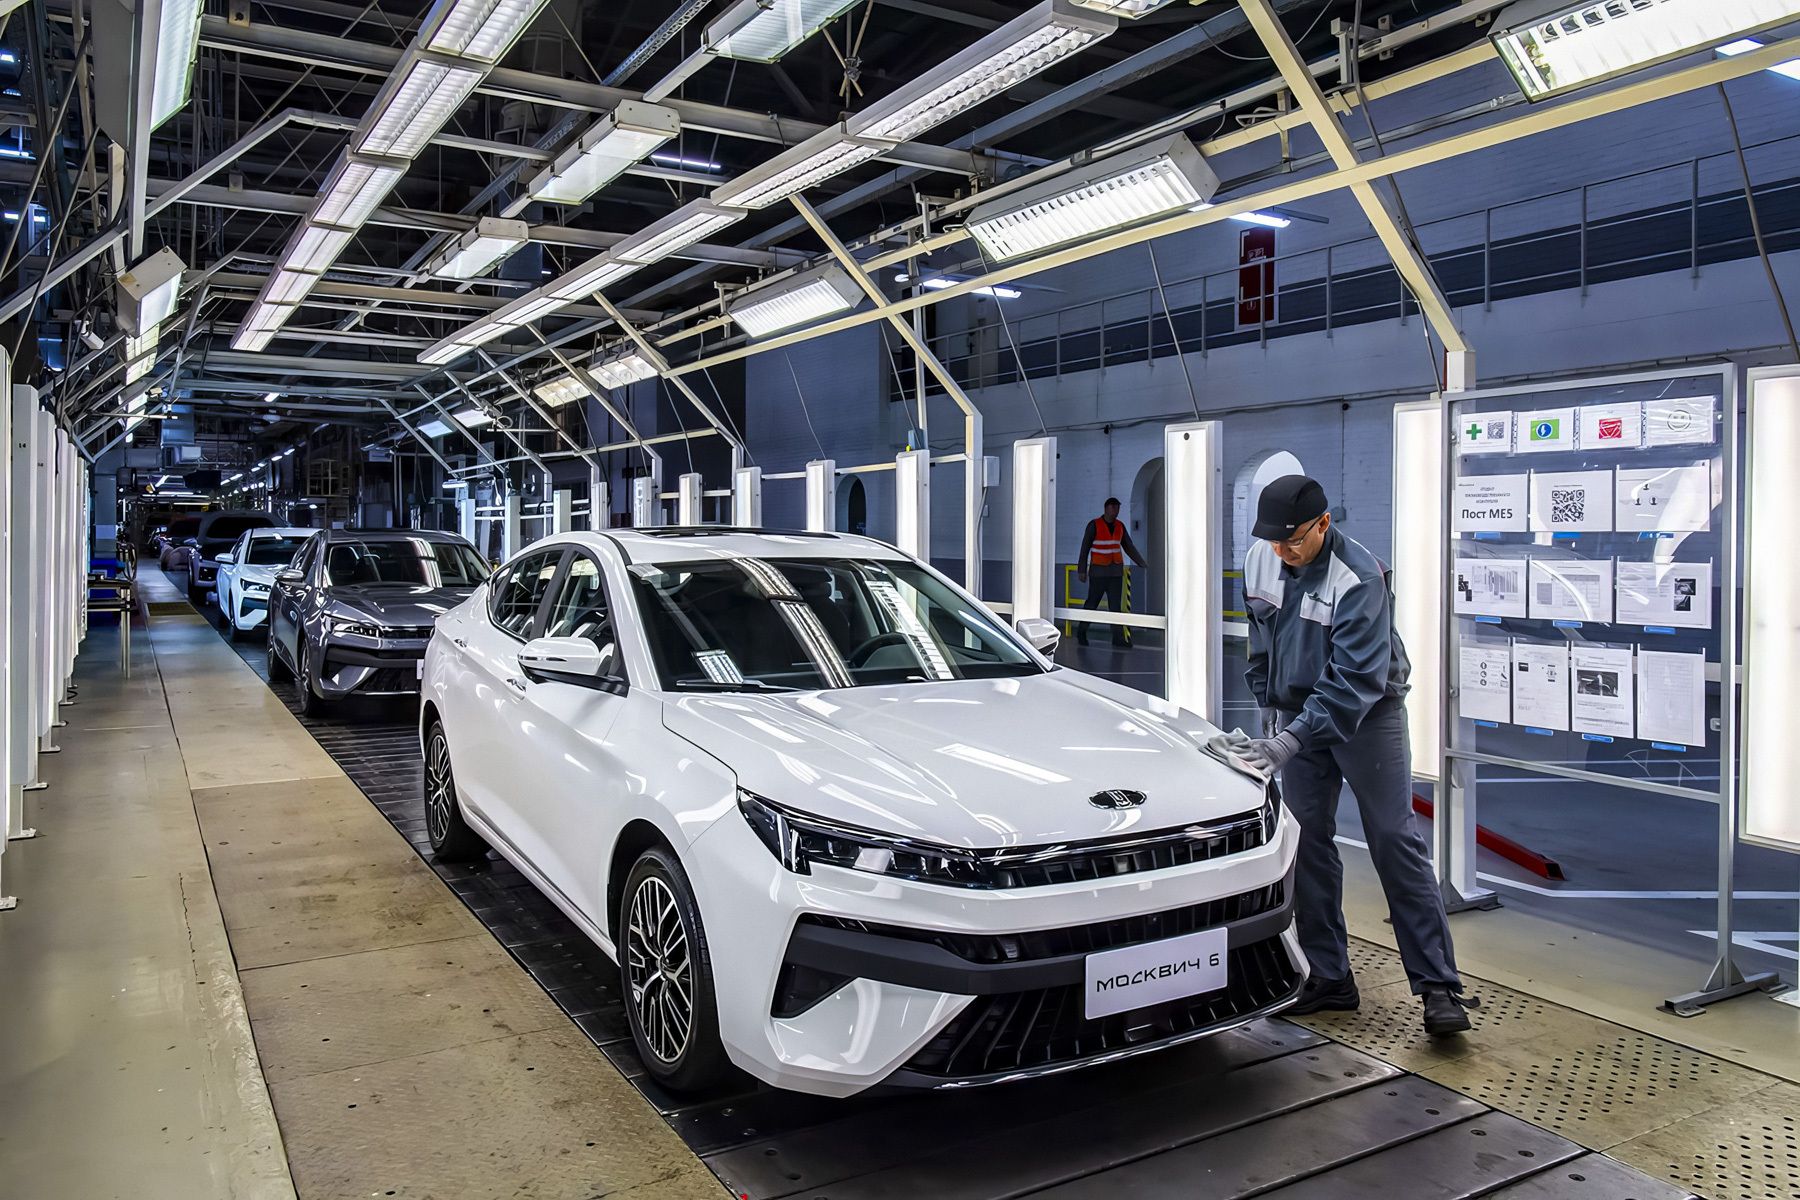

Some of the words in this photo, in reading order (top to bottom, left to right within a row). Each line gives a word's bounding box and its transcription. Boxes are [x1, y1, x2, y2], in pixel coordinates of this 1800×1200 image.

[1462, 509, 1486, 519] Пост
[1096, 958, 1200, 993] МОСКВИЧ
[1209, 953, 1220, 967] 6
